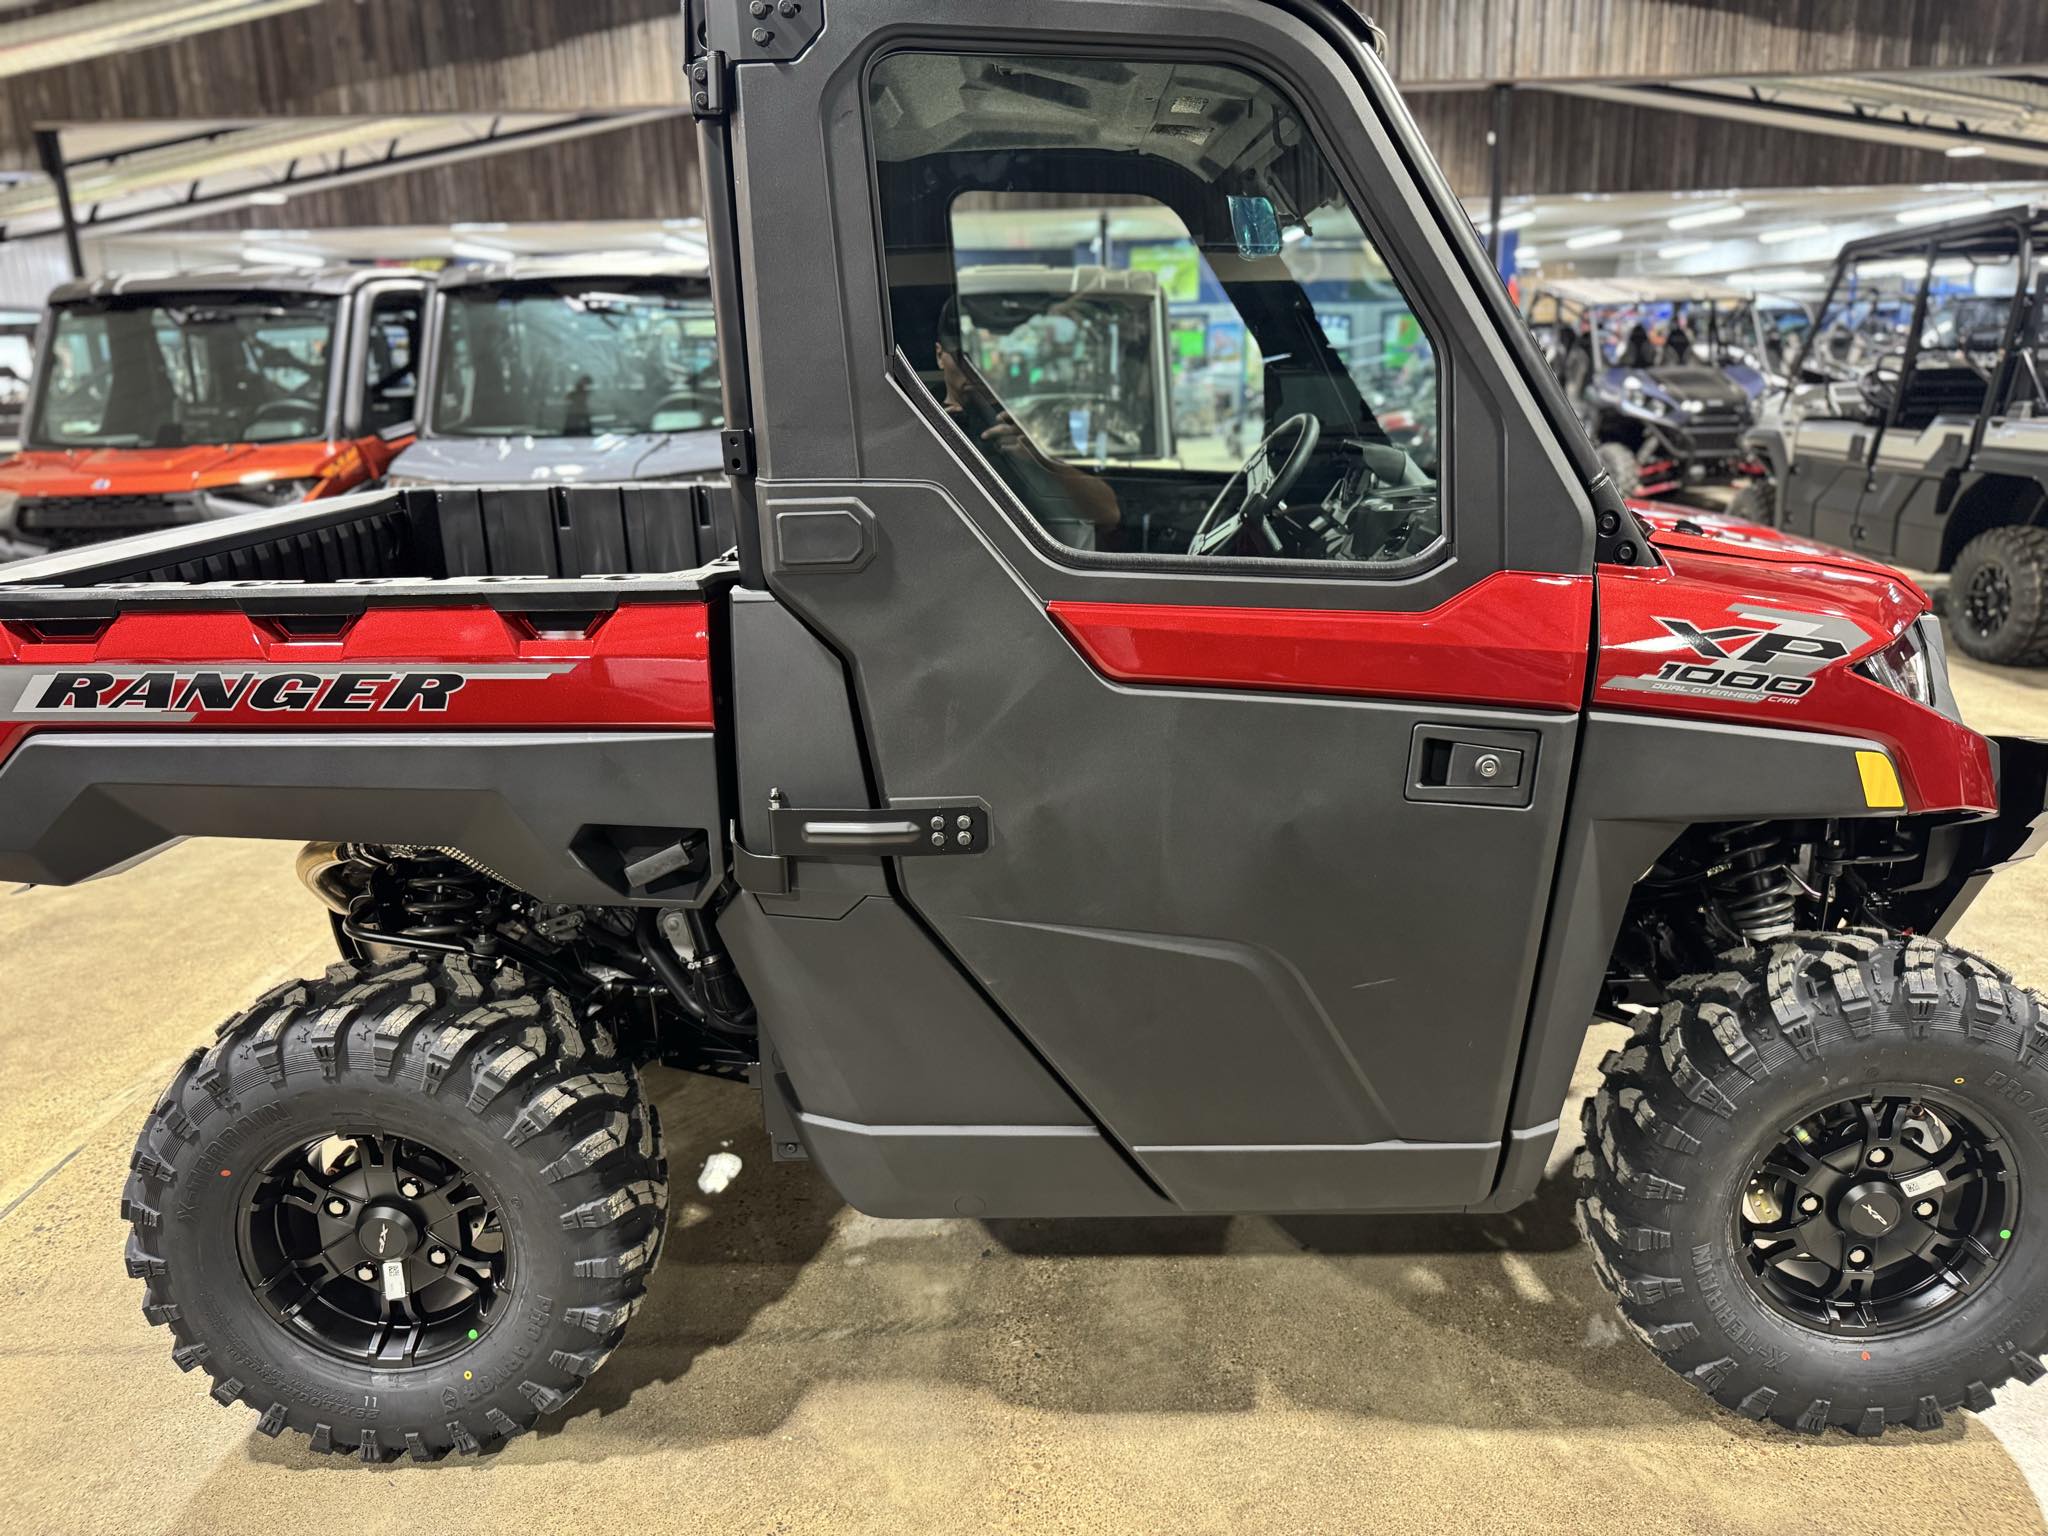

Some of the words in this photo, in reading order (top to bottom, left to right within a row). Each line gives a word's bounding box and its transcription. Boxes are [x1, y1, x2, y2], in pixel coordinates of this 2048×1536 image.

[1650, 615, 1850, 664] XP
[35, 671, 466, 712] RANGER
[1652, 683, 1689, 693] DUAL
[1690, 687, 1766, 701] OVERHEAD
[1767, 695, 1801, 705] CAM
[1658, 661, 1815, 697] 1000
[1691, 1242, 1793, 1374] X-TERRAIN
